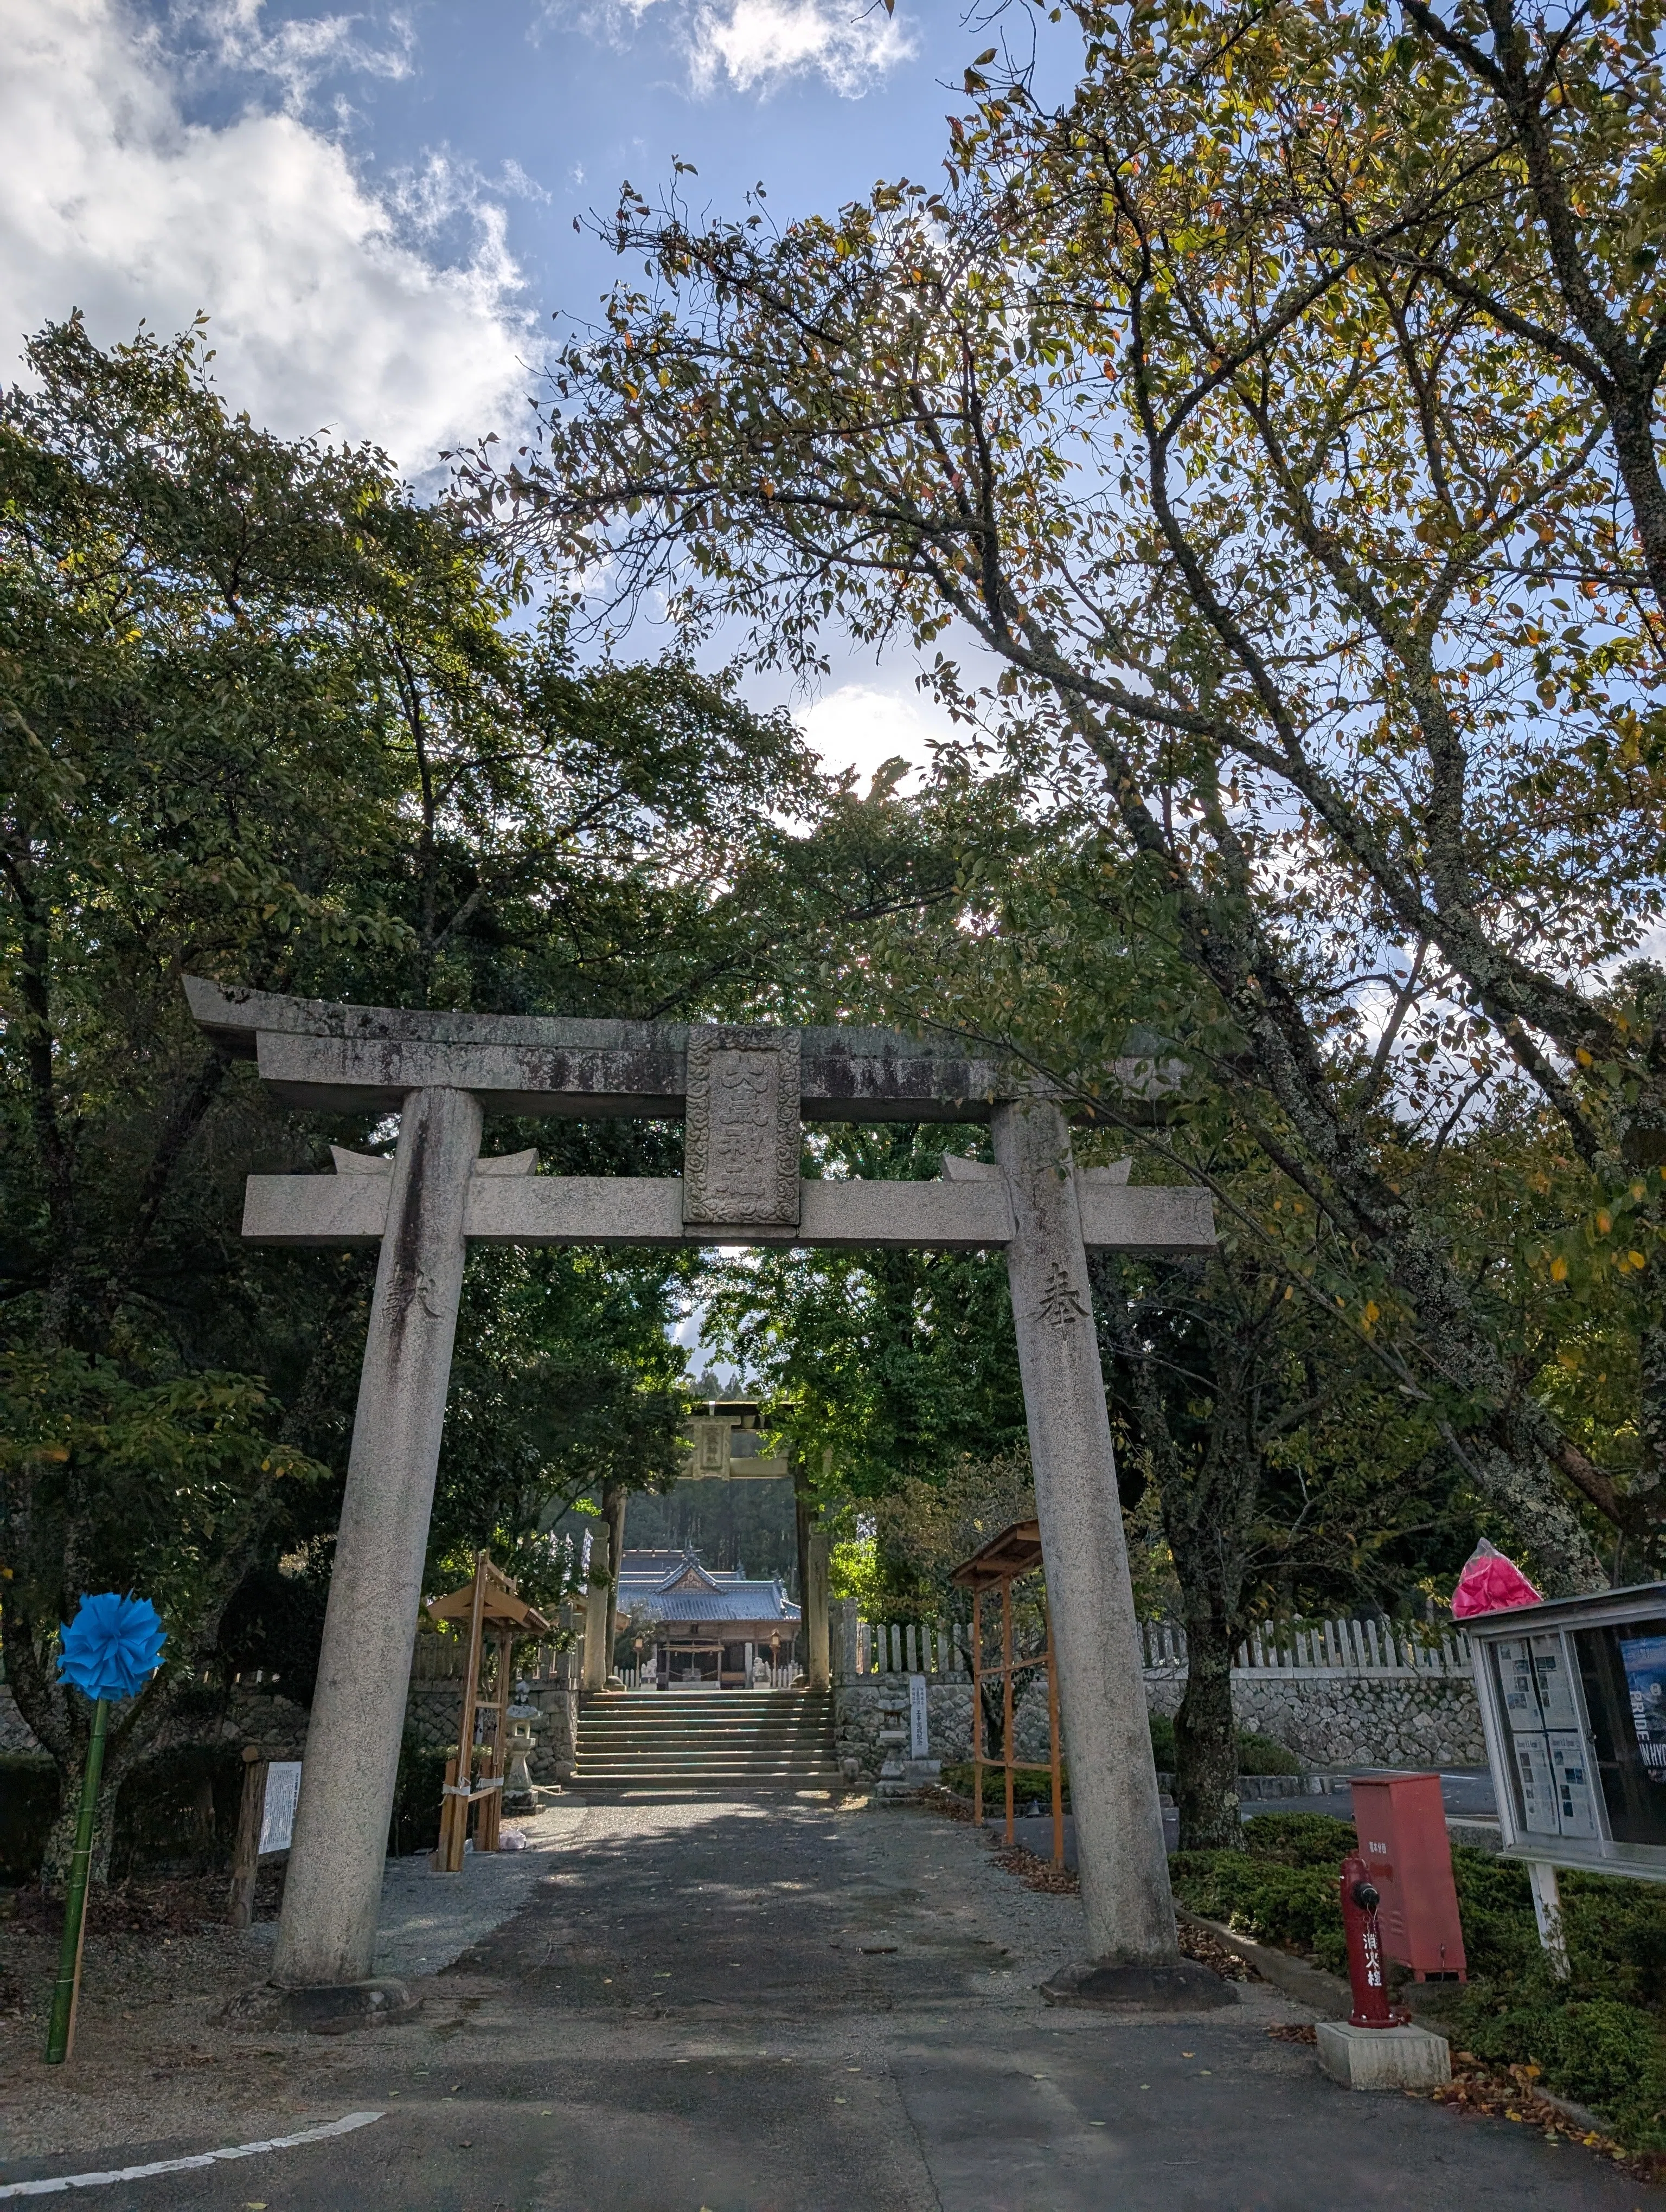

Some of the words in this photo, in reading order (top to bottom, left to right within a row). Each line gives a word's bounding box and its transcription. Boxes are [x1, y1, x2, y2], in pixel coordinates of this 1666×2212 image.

[1035, 1262, 1091, 1341] 奉
[1630, 1691, 1650, 1741] PRIDE
[1363, 1933, 1382, 1986] 消火栓
